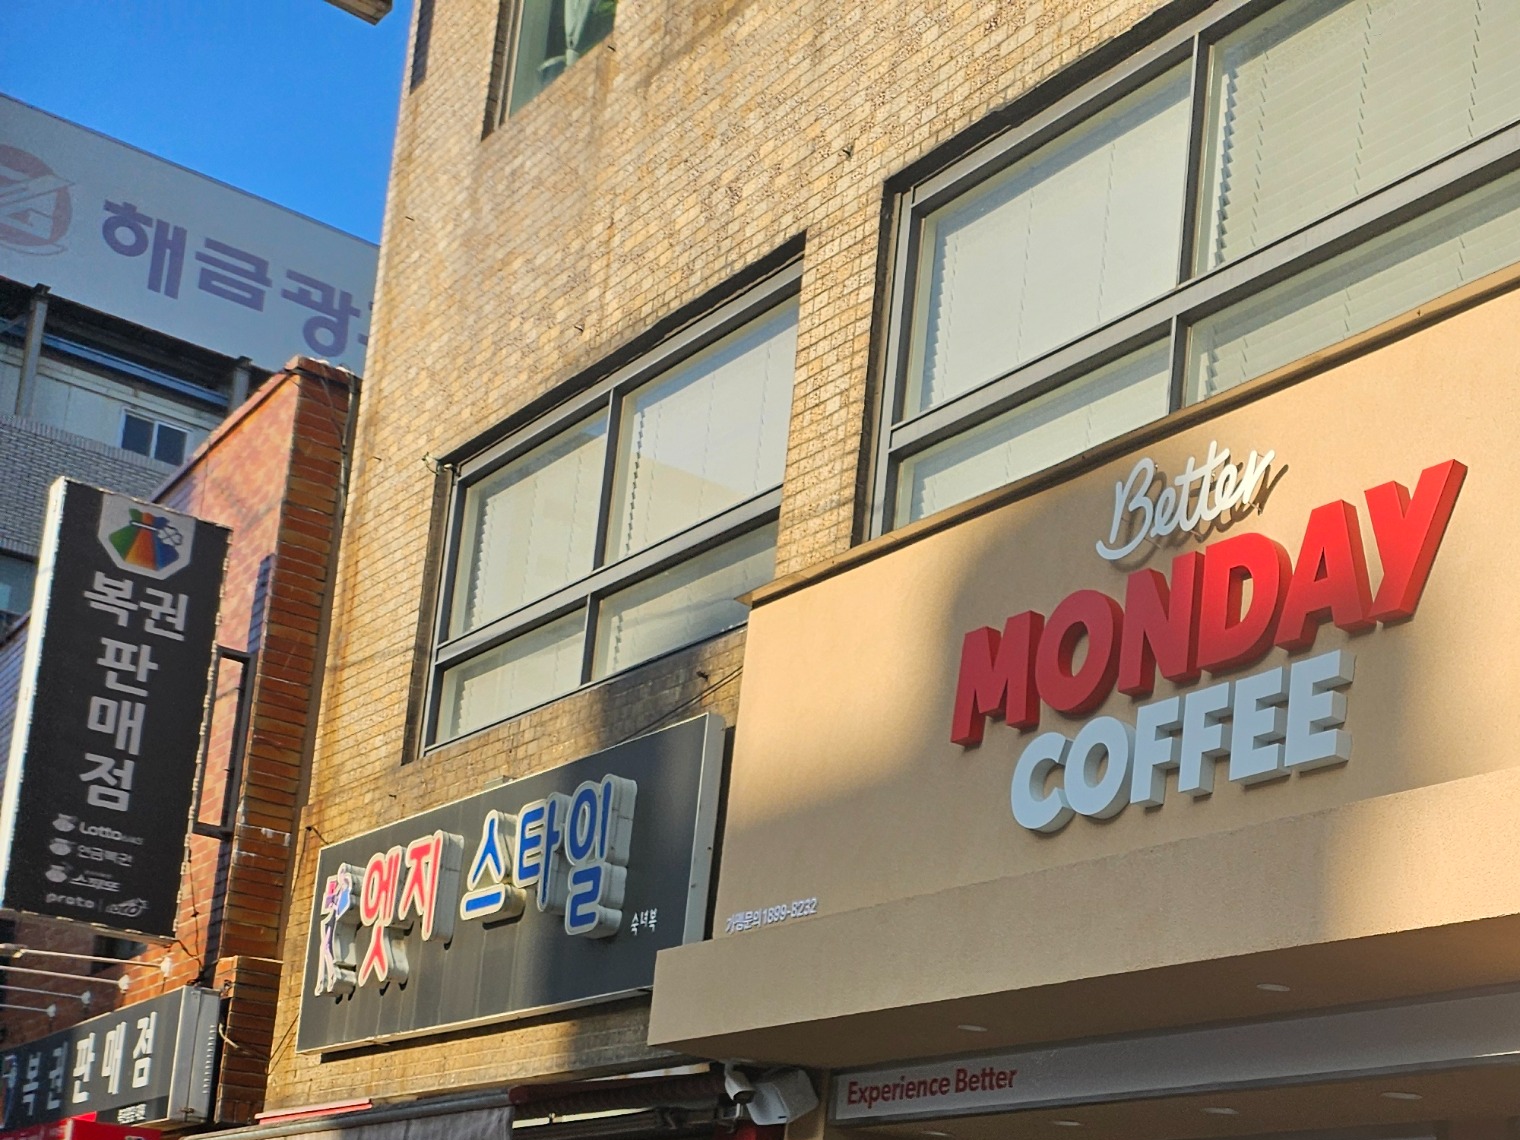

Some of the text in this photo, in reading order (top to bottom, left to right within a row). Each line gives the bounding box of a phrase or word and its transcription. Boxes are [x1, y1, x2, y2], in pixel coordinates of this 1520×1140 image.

[102, 200, 375, 358] 해금광
[1096, 440, 1276, 560] Better
[84, 571, 188, 641] 복권
[951, 459, 1467, 746] MONDAY
[1011, 650, 1355, 833] COFFEE
[460, 773, 617, 936] 스타일
[630, 907, 658, 937] 숙녀복
[847, 1066, 1018, 1109] Experience Better
